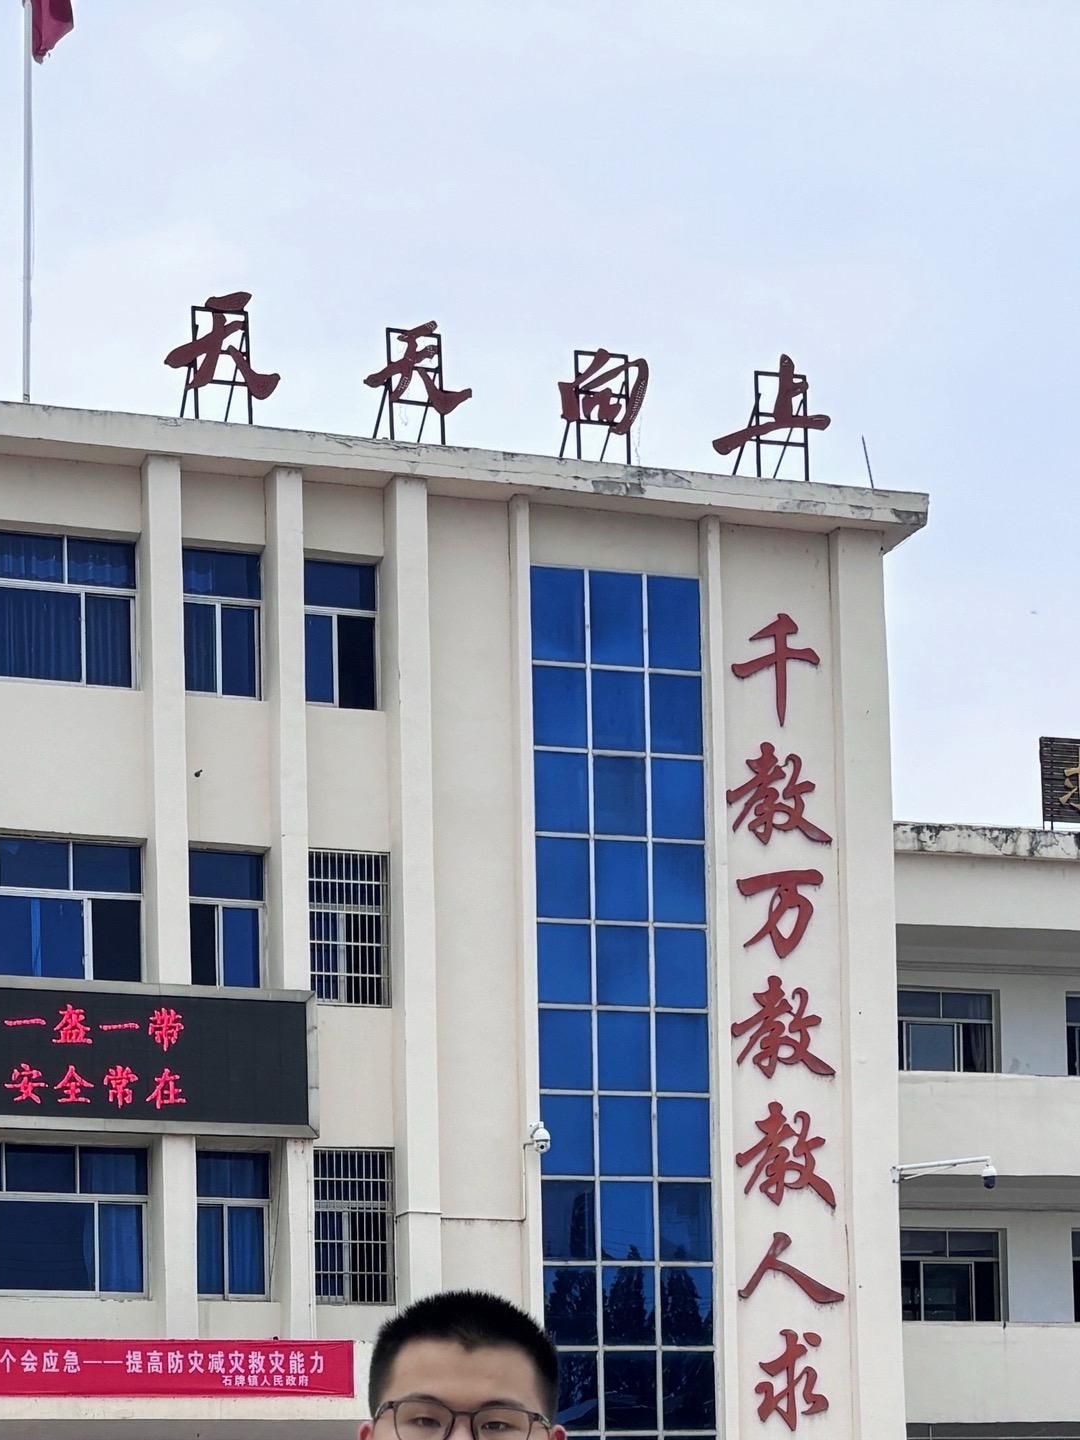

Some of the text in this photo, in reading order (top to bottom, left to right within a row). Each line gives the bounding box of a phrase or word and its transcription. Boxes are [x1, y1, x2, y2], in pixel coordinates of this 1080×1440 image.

[164, 291, 831, 455] 天天向上
[4, 1004, 185, 1052] 一盔一带
[4, 1063, 188, 1109] 安全常在
[222, 1375, 309, 1387] 石牌镇人民政府
